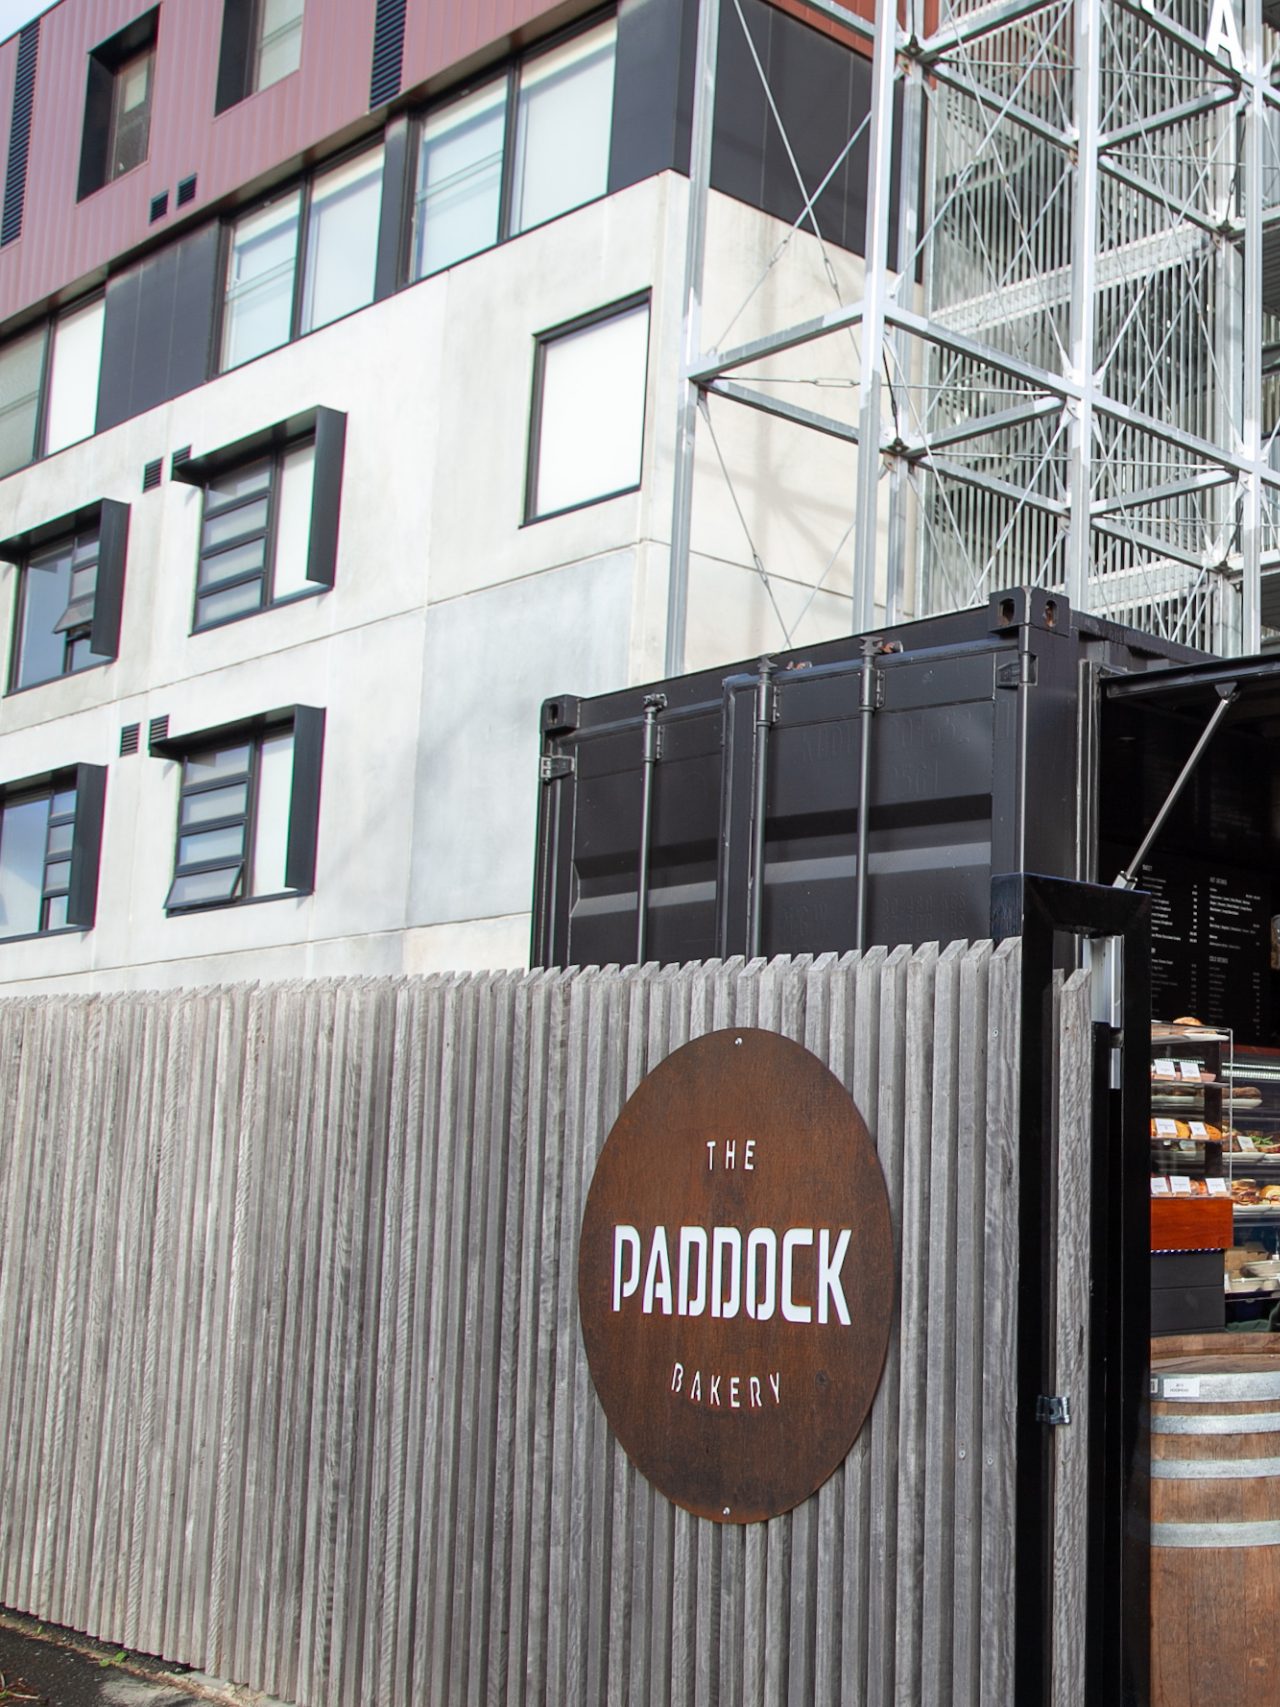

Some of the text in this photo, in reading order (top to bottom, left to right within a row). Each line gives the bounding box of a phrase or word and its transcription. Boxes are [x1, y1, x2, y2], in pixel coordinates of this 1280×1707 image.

[707, 1140, 756, 1170] THE
[612, 1225, 852, 1326] PADDOCK
[671, 1363, 781, 1408] BAKERY
